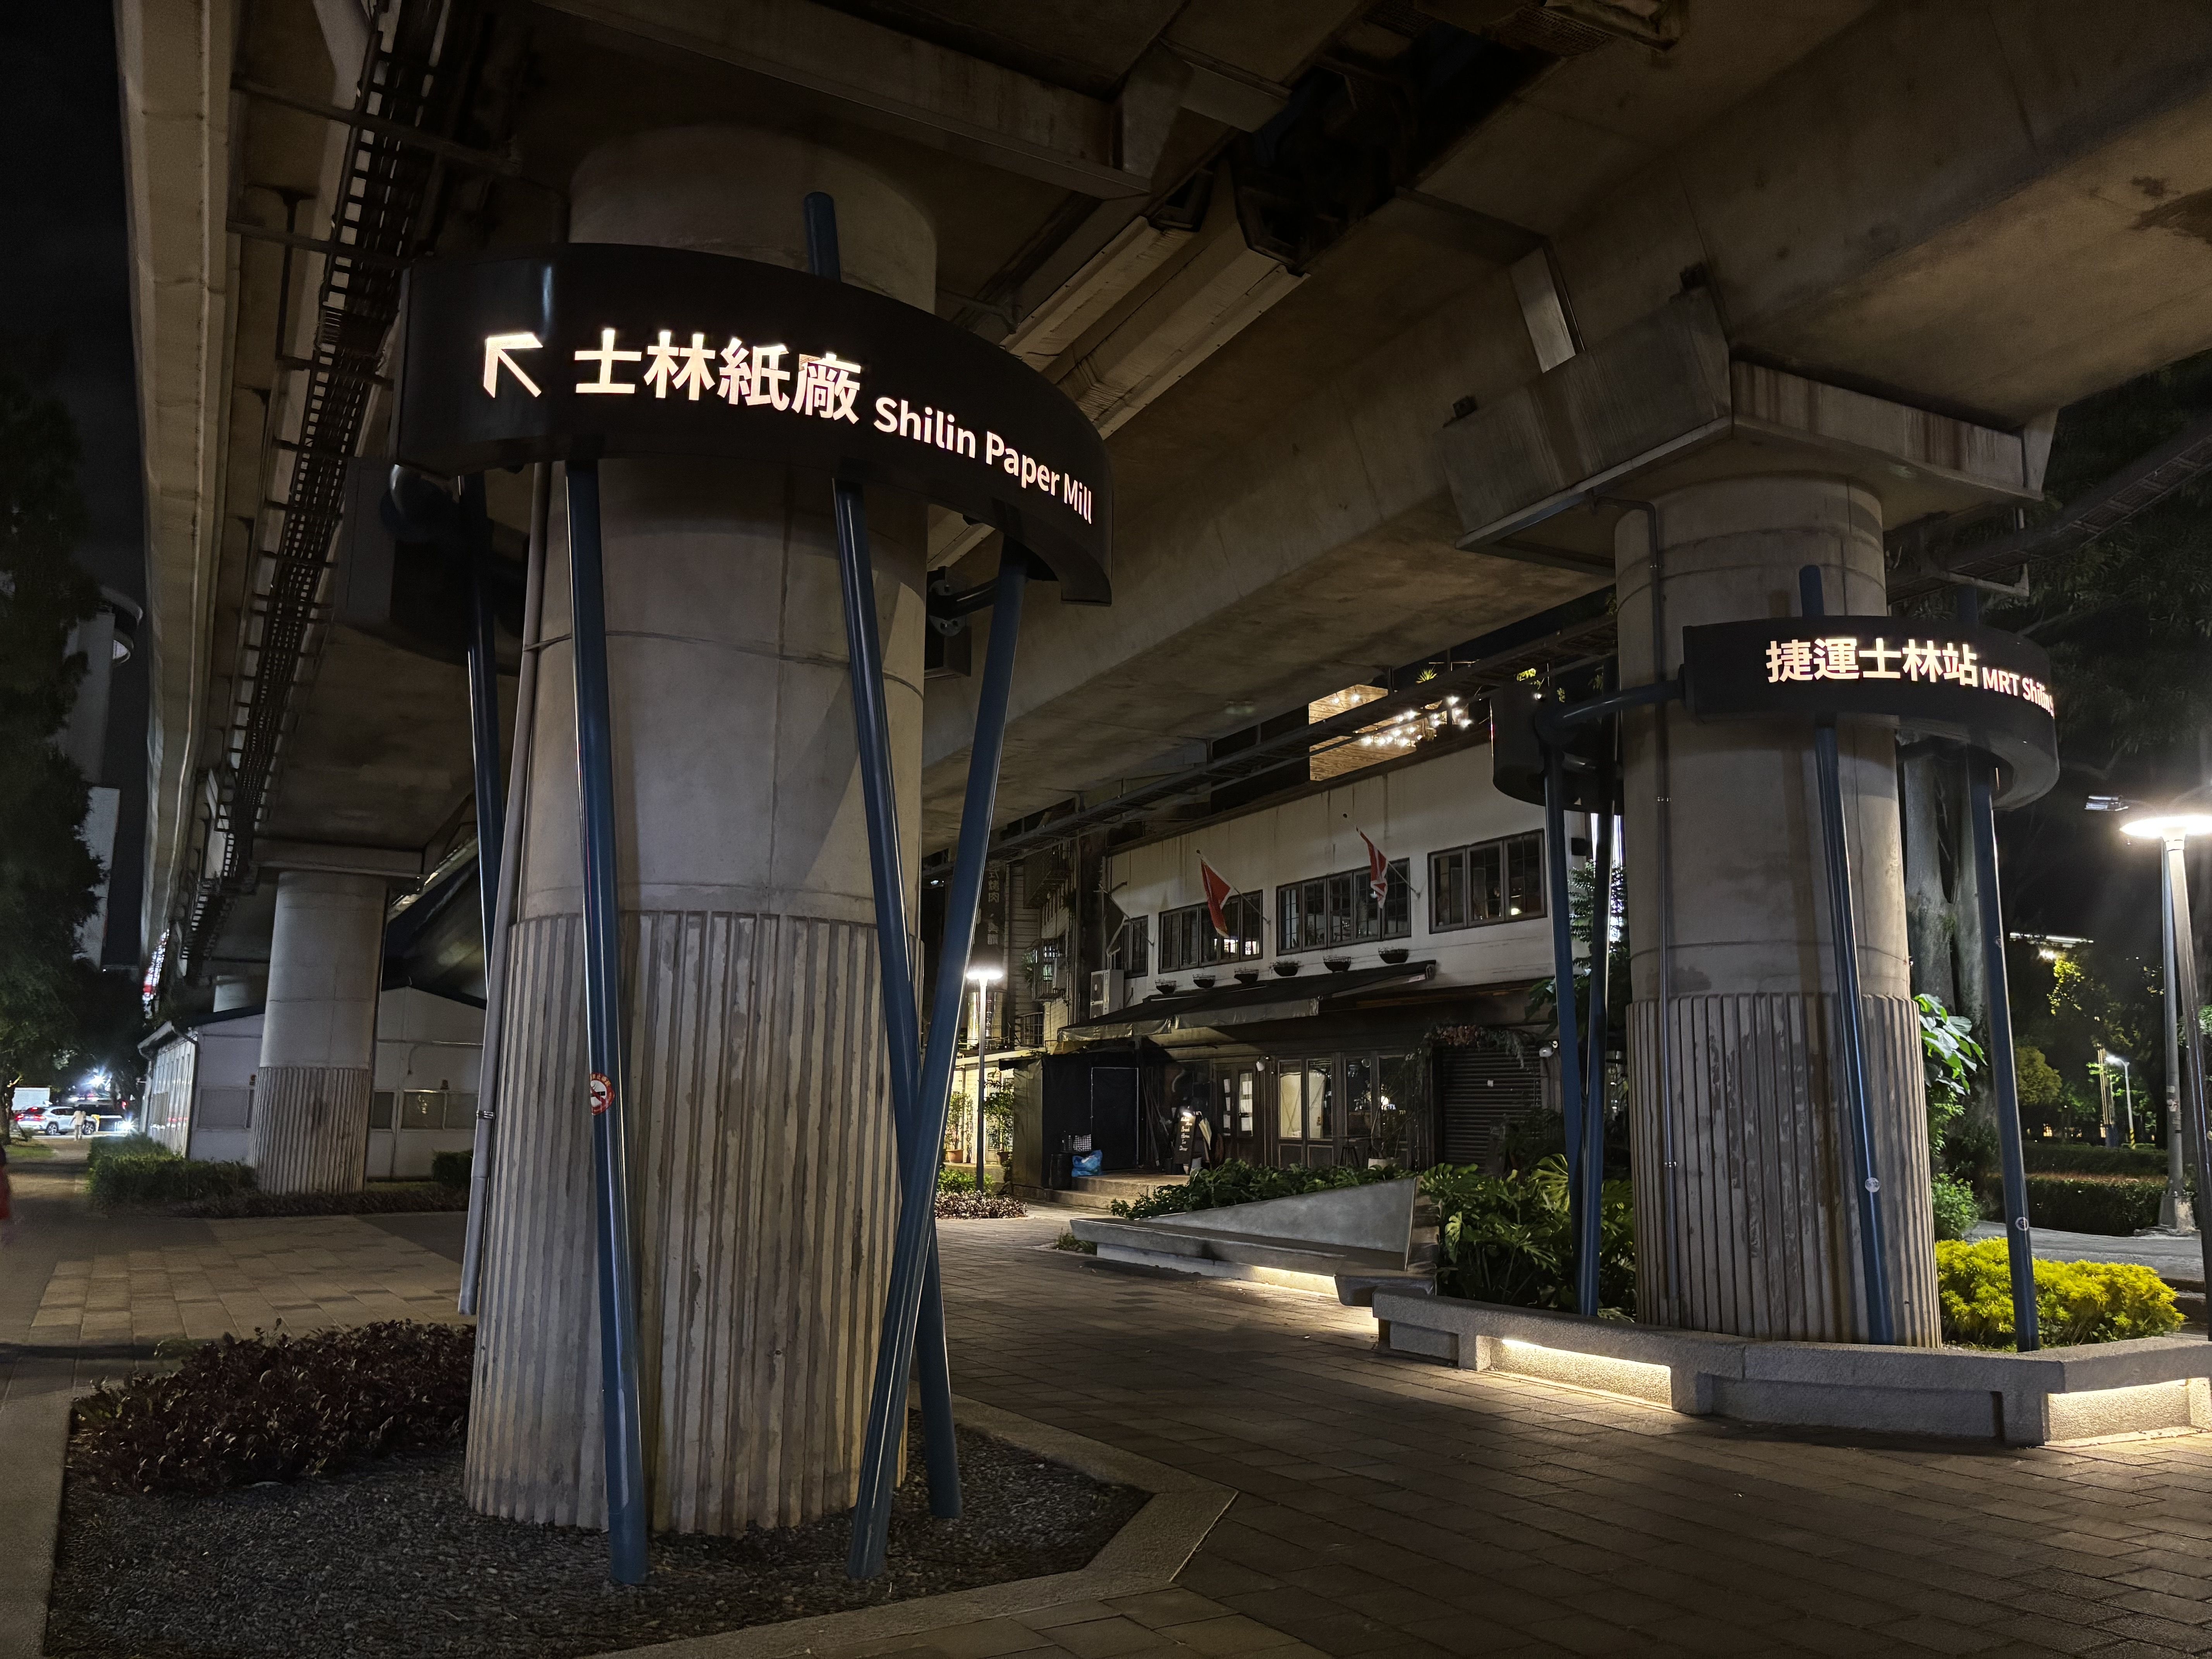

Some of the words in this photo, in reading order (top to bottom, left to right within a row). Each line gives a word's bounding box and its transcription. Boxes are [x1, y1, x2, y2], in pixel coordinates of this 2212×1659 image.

[574, 327, 862, 424] 士林紙廠
[873, 396, 976, 459] Shilin
[986, 431, 1060, 496] Paper
[1063, 472, 1092, 525] Mill
[1765, 637, 1978, 688] 捷運士林站
[1982, 666, 2020, 697] MRT
